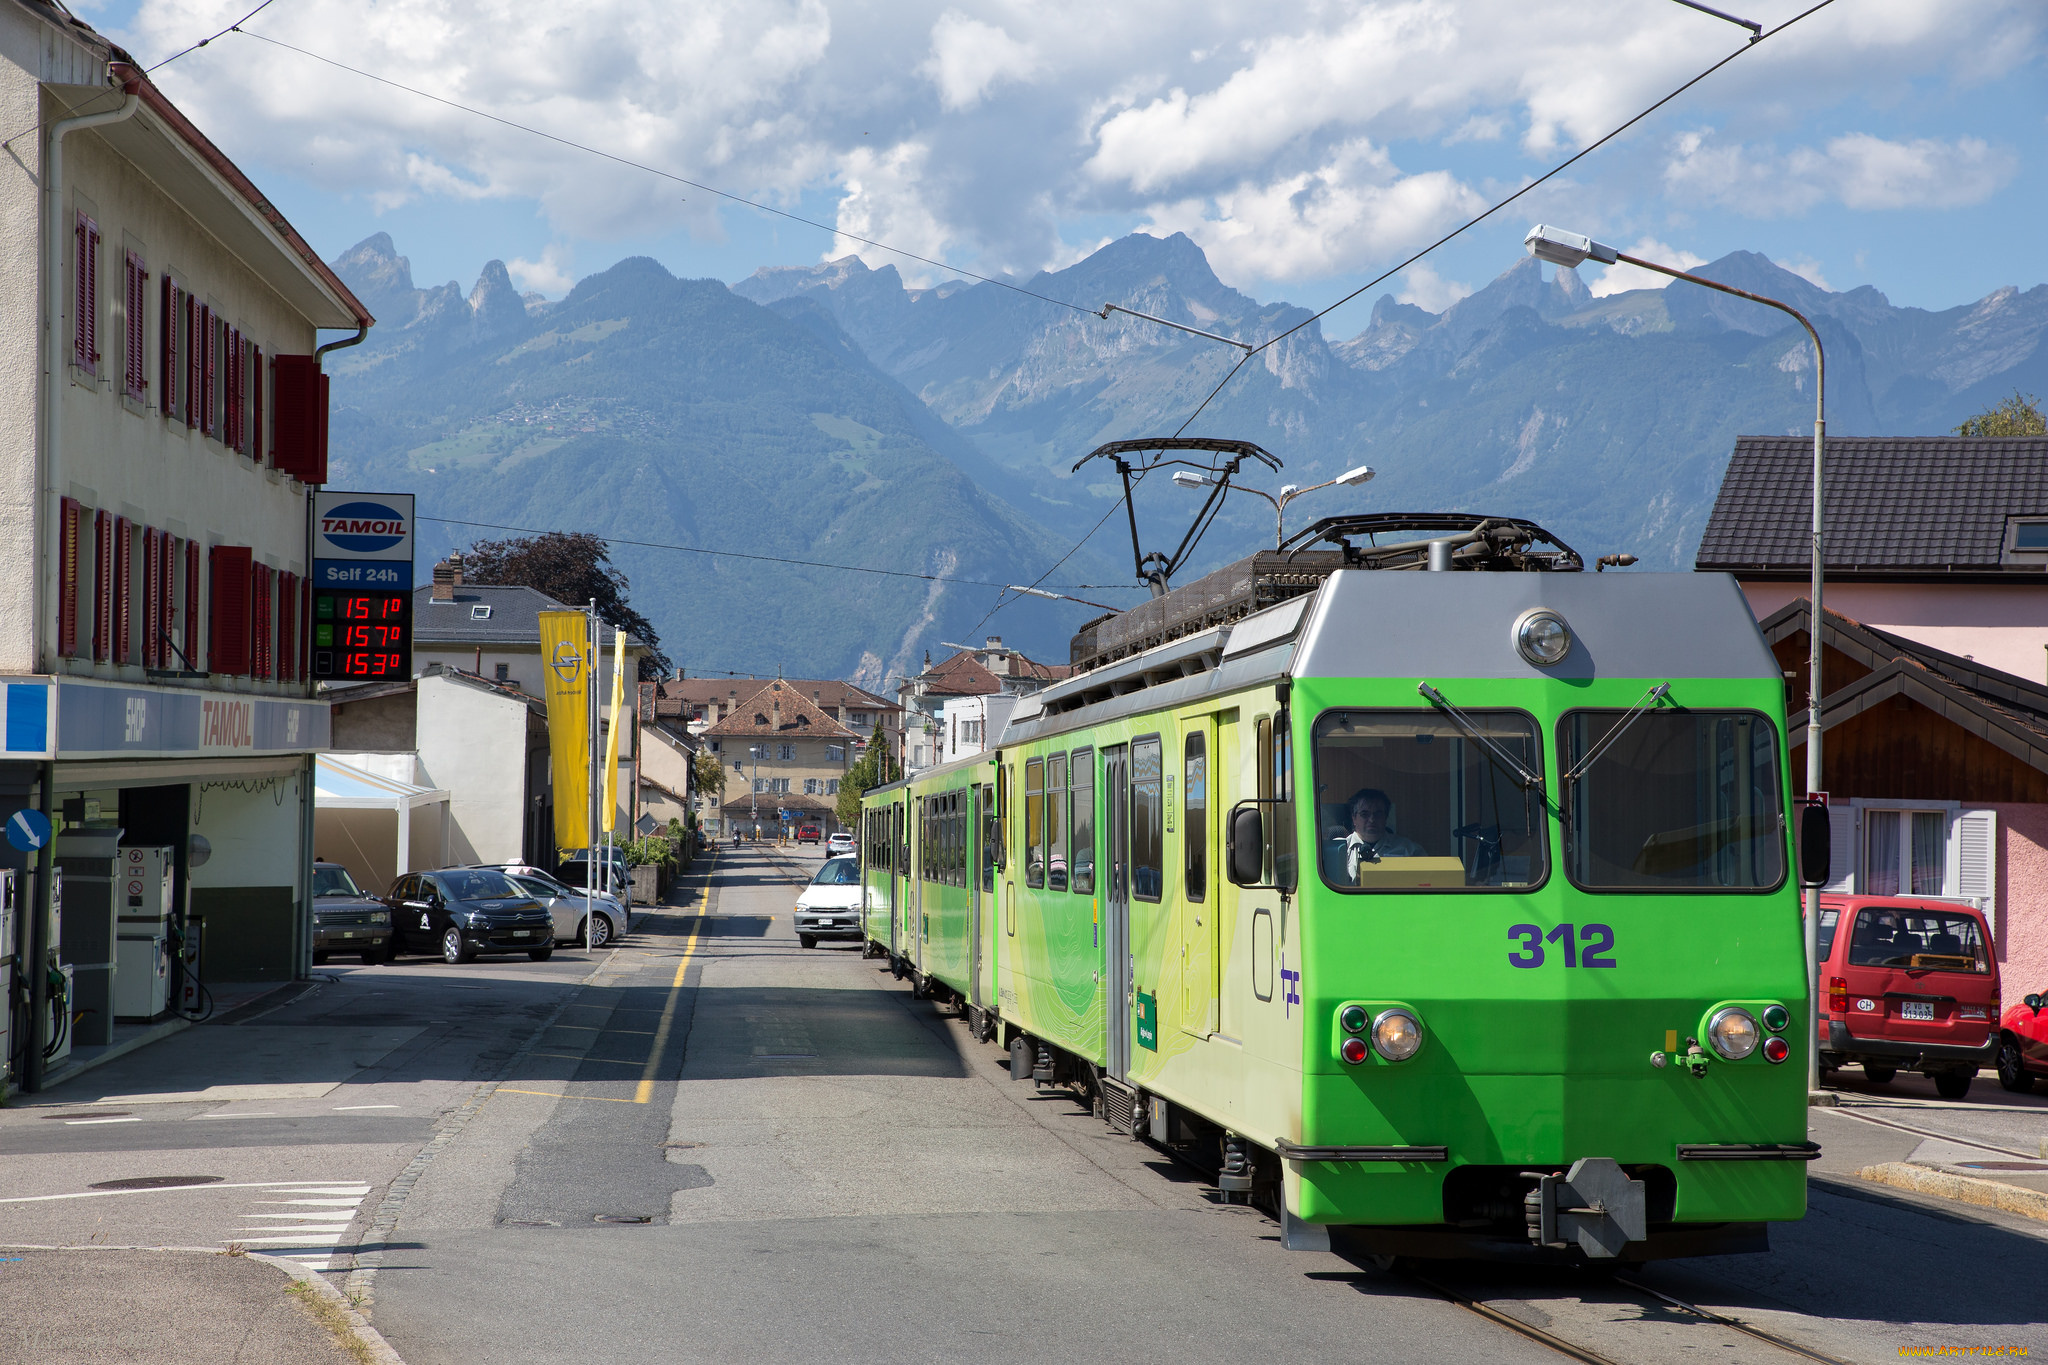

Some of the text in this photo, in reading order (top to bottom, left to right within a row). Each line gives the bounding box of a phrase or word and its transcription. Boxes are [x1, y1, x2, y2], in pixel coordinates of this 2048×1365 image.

[321, 519, 407, 535] TAMOIL
[327, 567, 398, 582] Self 24h
[125, 697, 146, 743] SHOP
[203, 700, 251, 748] TAMOIL
[1507, 923, 1617, 969] 312
[1859, 1000, 1872, 1010] CH
